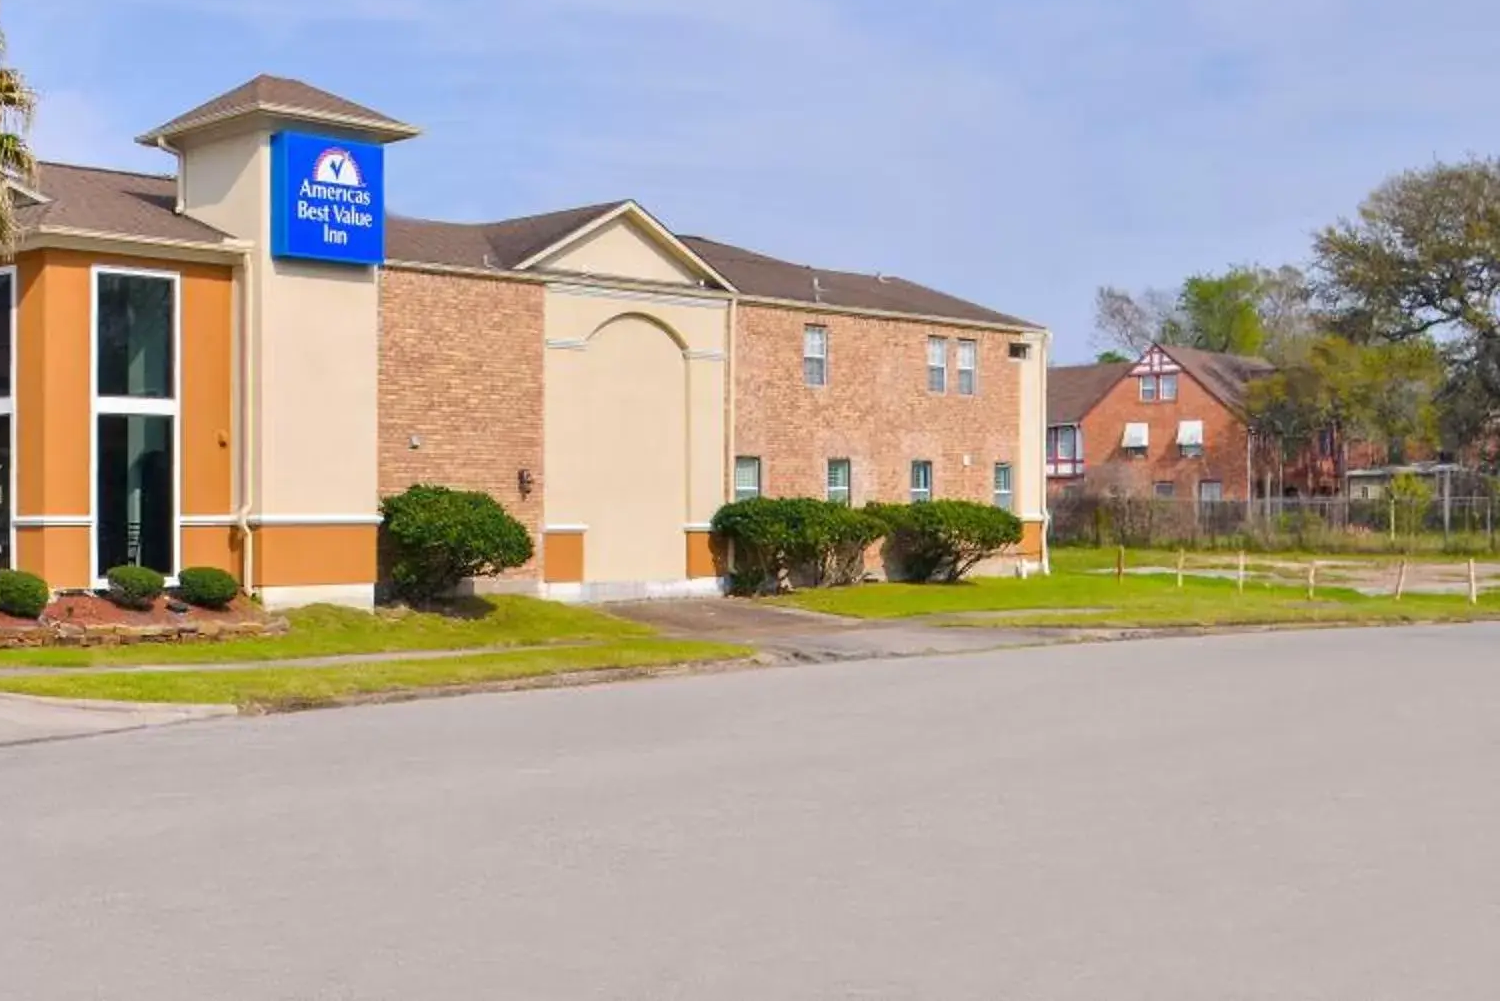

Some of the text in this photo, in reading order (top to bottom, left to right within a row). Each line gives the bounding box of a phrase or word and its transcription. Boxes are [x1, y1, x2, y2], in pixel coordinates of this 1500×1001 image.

[299, 178, 371, 205] Americas
[297, 200, 373, 227] Best Value
[323, 223, 347, 245] Inn
